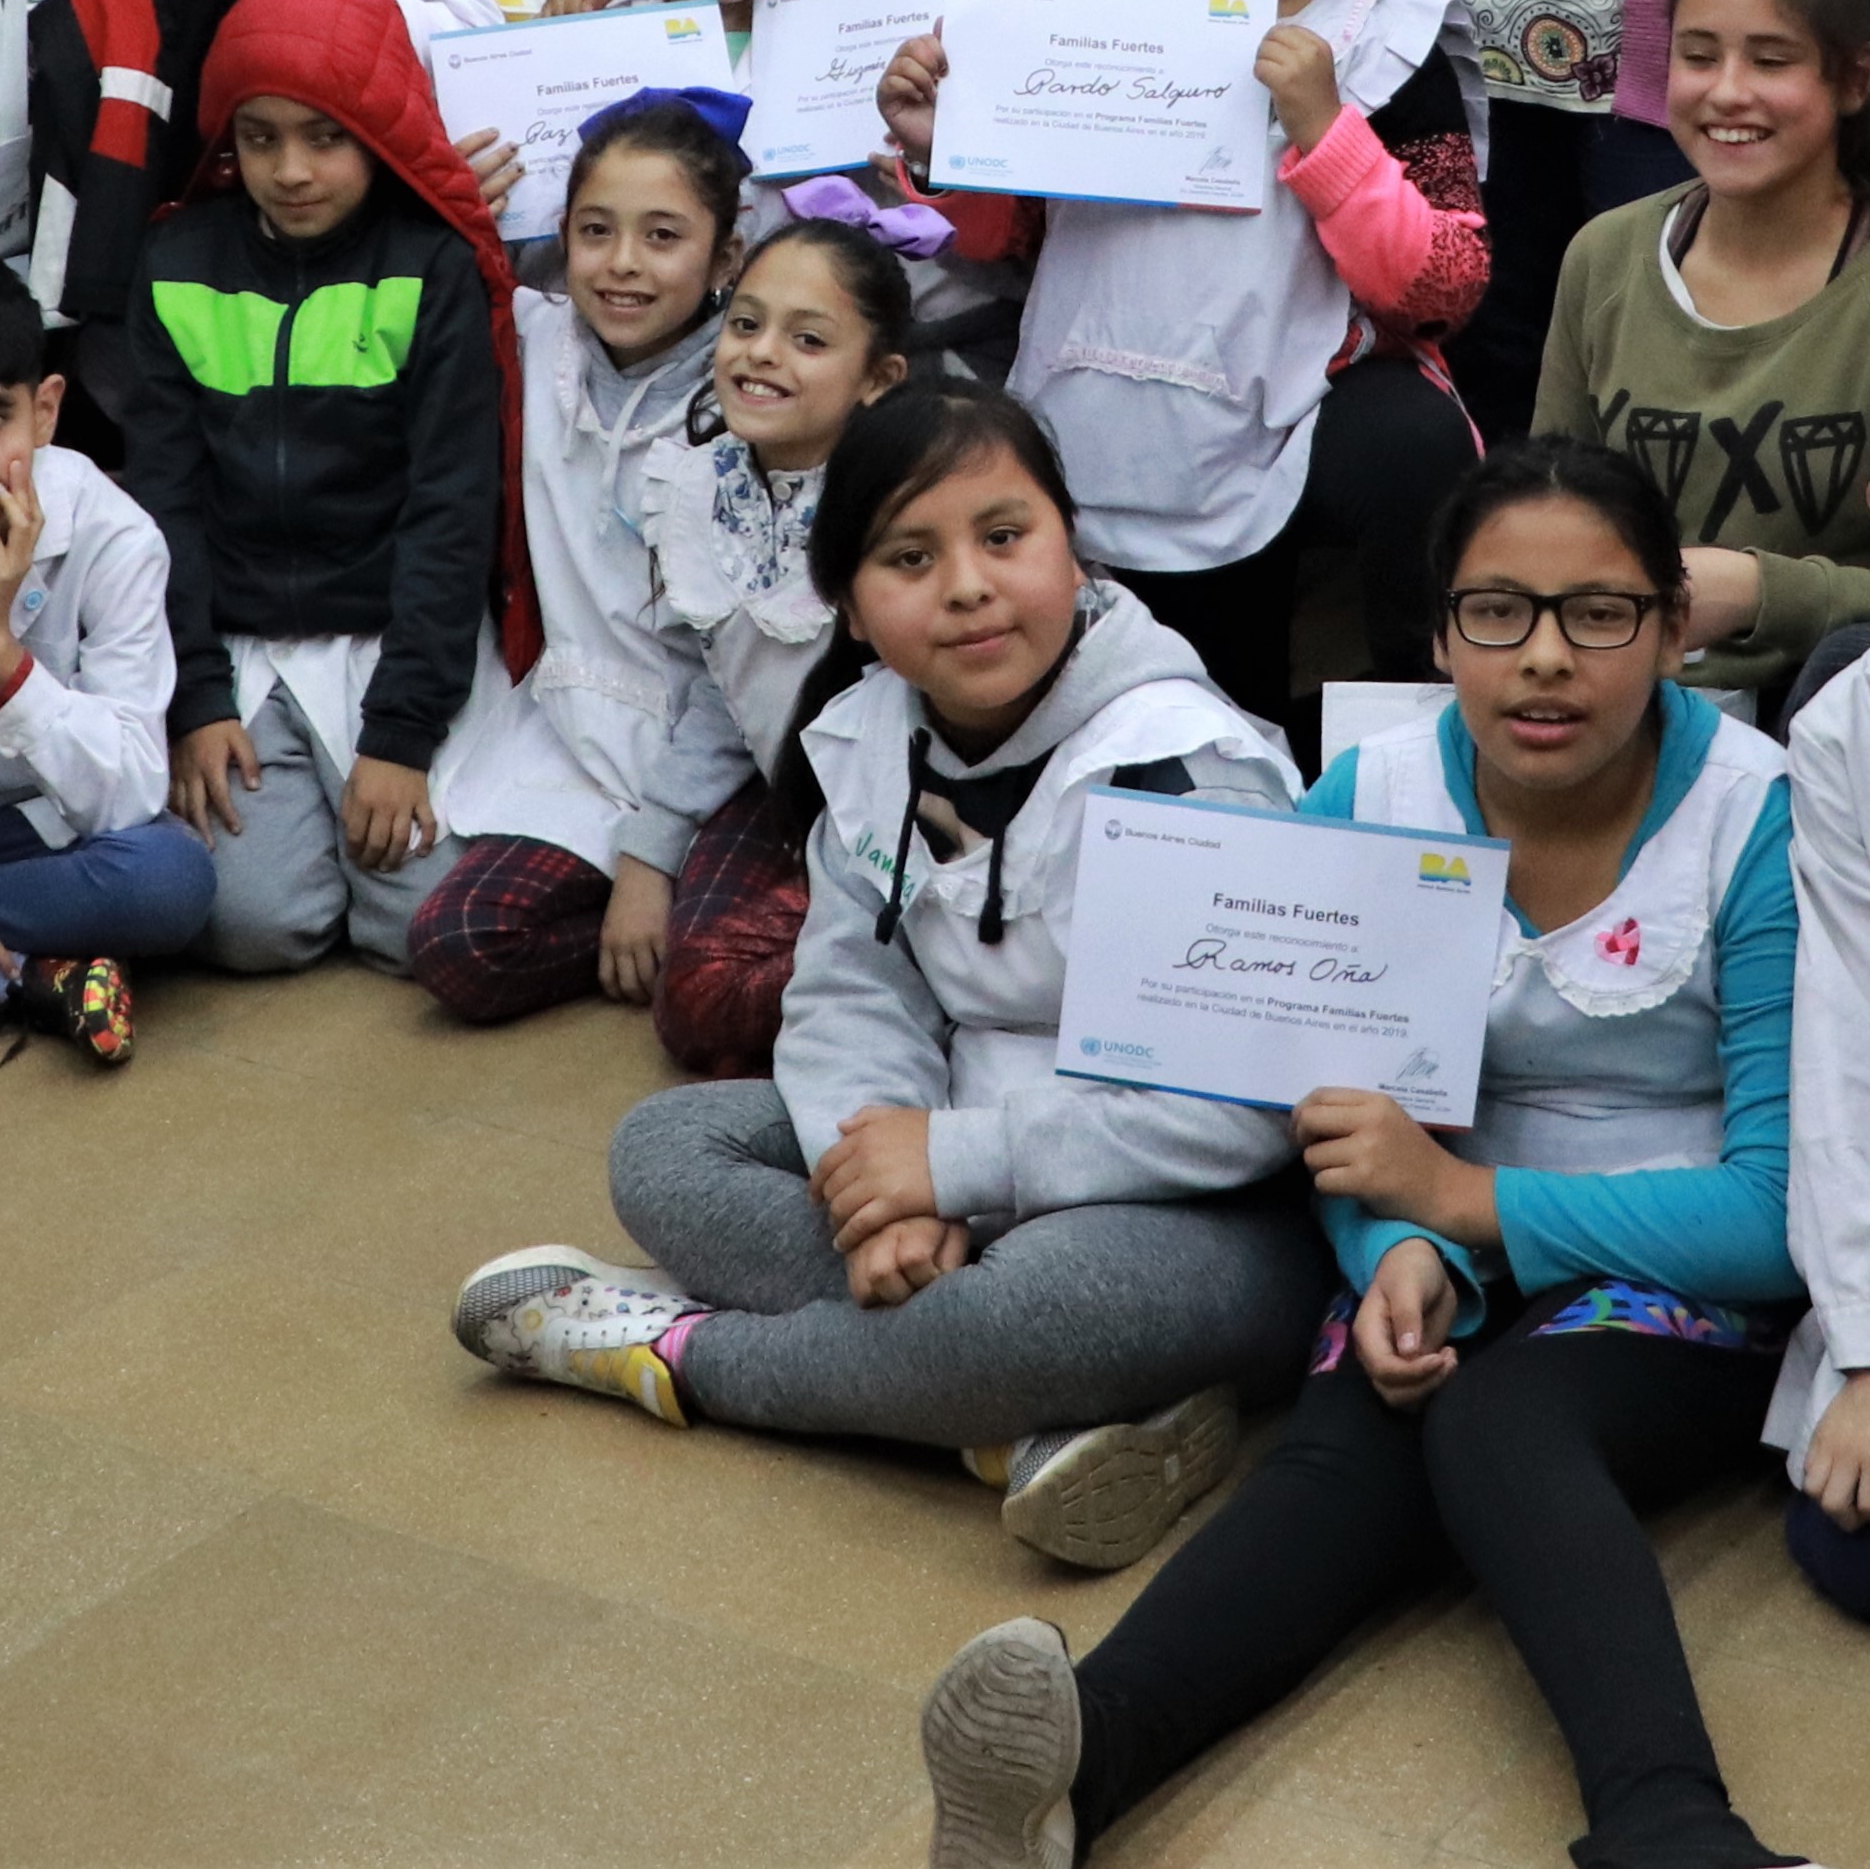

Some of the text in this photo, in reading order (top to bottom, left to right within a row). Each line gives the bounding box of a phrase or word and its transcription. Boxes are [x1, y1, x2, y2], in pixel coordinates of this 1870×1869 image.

[837, 12, 930, 34] Familias Fuertes
[1049, 34, 1165, 54] Familias Fuertes
[536, 72, 639, 97] Familias Fuertes
[1013, 68, 1120, 96] Pardo
[967, 156, 1009, 169] UNODC
[1123, 827, 1222, 850] Buenos Aires Ciudad
[1212, 892, 1360, 927] Familias Fuertes
[1205, 922, 1349, 953] Otorga este reconocimiento
[1173, 938, 1389, 983] Ramos Oña
[1136, 992, 1182, 1008] realizado
[1184, 1000, 1197, 1009] en
[1200, 1000, 1209, 1011] la
[1211, 1003, 1247, 1018] Ciudad
[1249, 1008, 1262, 1019] de
[1264, 1011, 1302, 1027] Buenos
[1304, 1016, 1331, 1030] Aires
[1333, 1022, 1346, 1031] en
[1348, 1021, 1357, 1032] el
[1360, 1025, 1379, 1035] año
[1140, 977, 1409, 1024] Por su participación en el Programa Familias Fuertes
[1103, 1040, 1154, 1059] UNODC
